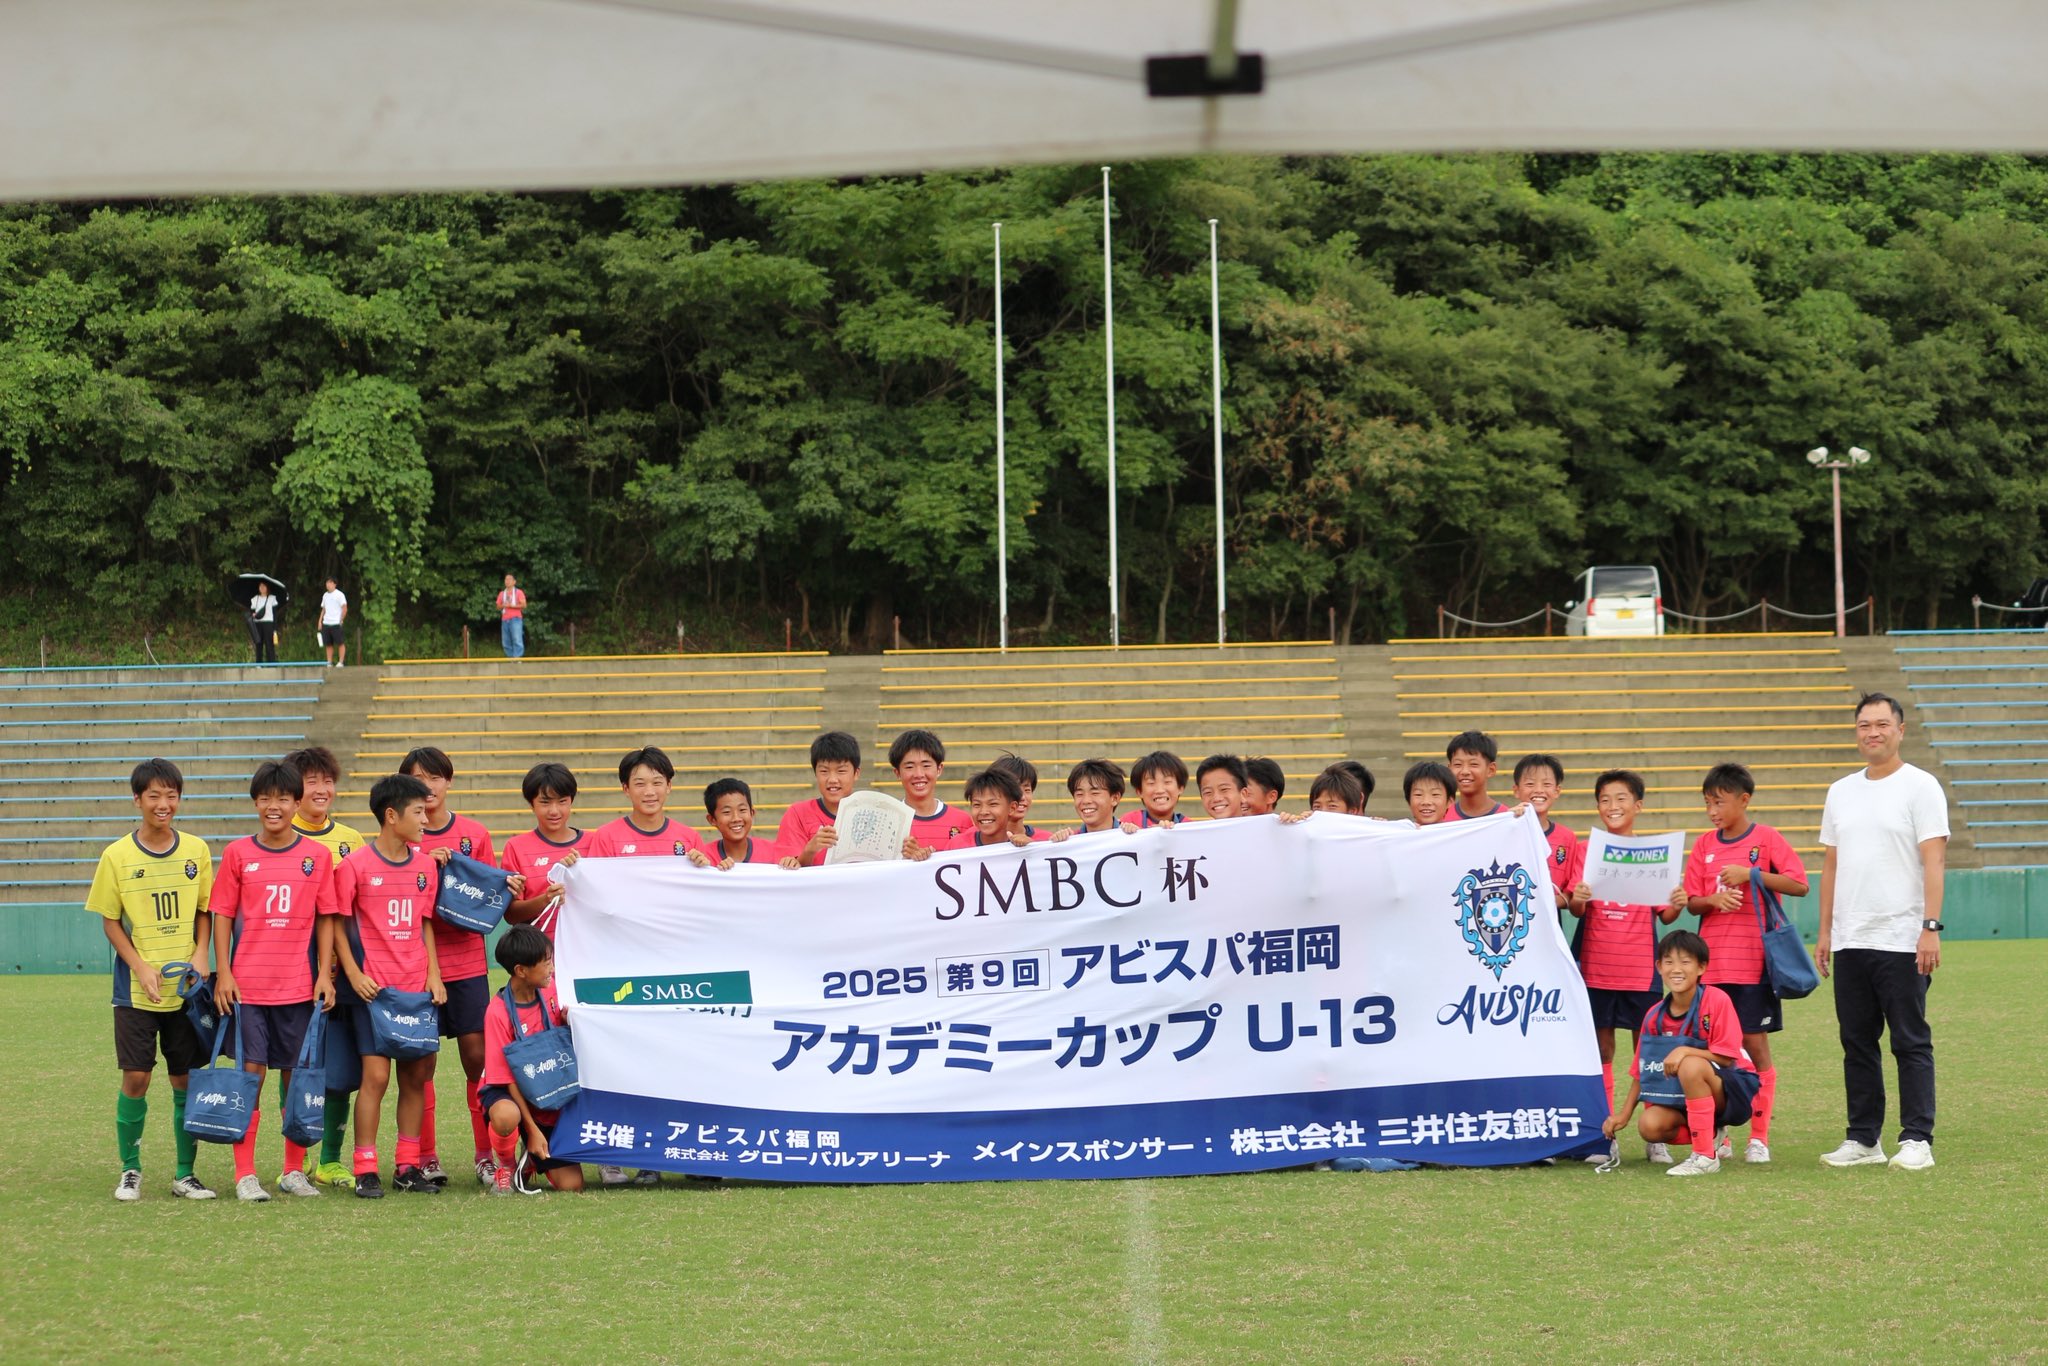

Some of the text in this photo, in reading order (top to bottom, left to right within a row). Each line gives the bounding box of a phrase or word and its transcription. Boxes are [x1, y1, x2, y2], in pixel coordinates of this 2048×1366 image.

[1631, 848, 1666, 862] YONEX
[265, 884, 291, 914] 78
[934, 851, 1209, 921] SMBC 杯
[151, 890, 180, 921] 101
[387, 898, 413, 927] 94
[822, 924, 1341, 999] 2025 第9回 アビスパ福岡
[641, 982, 714, 1000] SMBC
[1436, 980, 1565, 1038] Avispa
[1531, 1015, 1567, 1023] FUKUOKA
[771, 995, 1397, 1076] アカデミーカップ U-13
[666, 1121, 841, 1149] アビスパ福岡
[1230, 1120, 1367, 1156] 株式会社
[1377, 1107, 1582, 1147] 三井住友銀行
[664, 1147, 952, 1169] 株式会社 グローバルアリーナ
